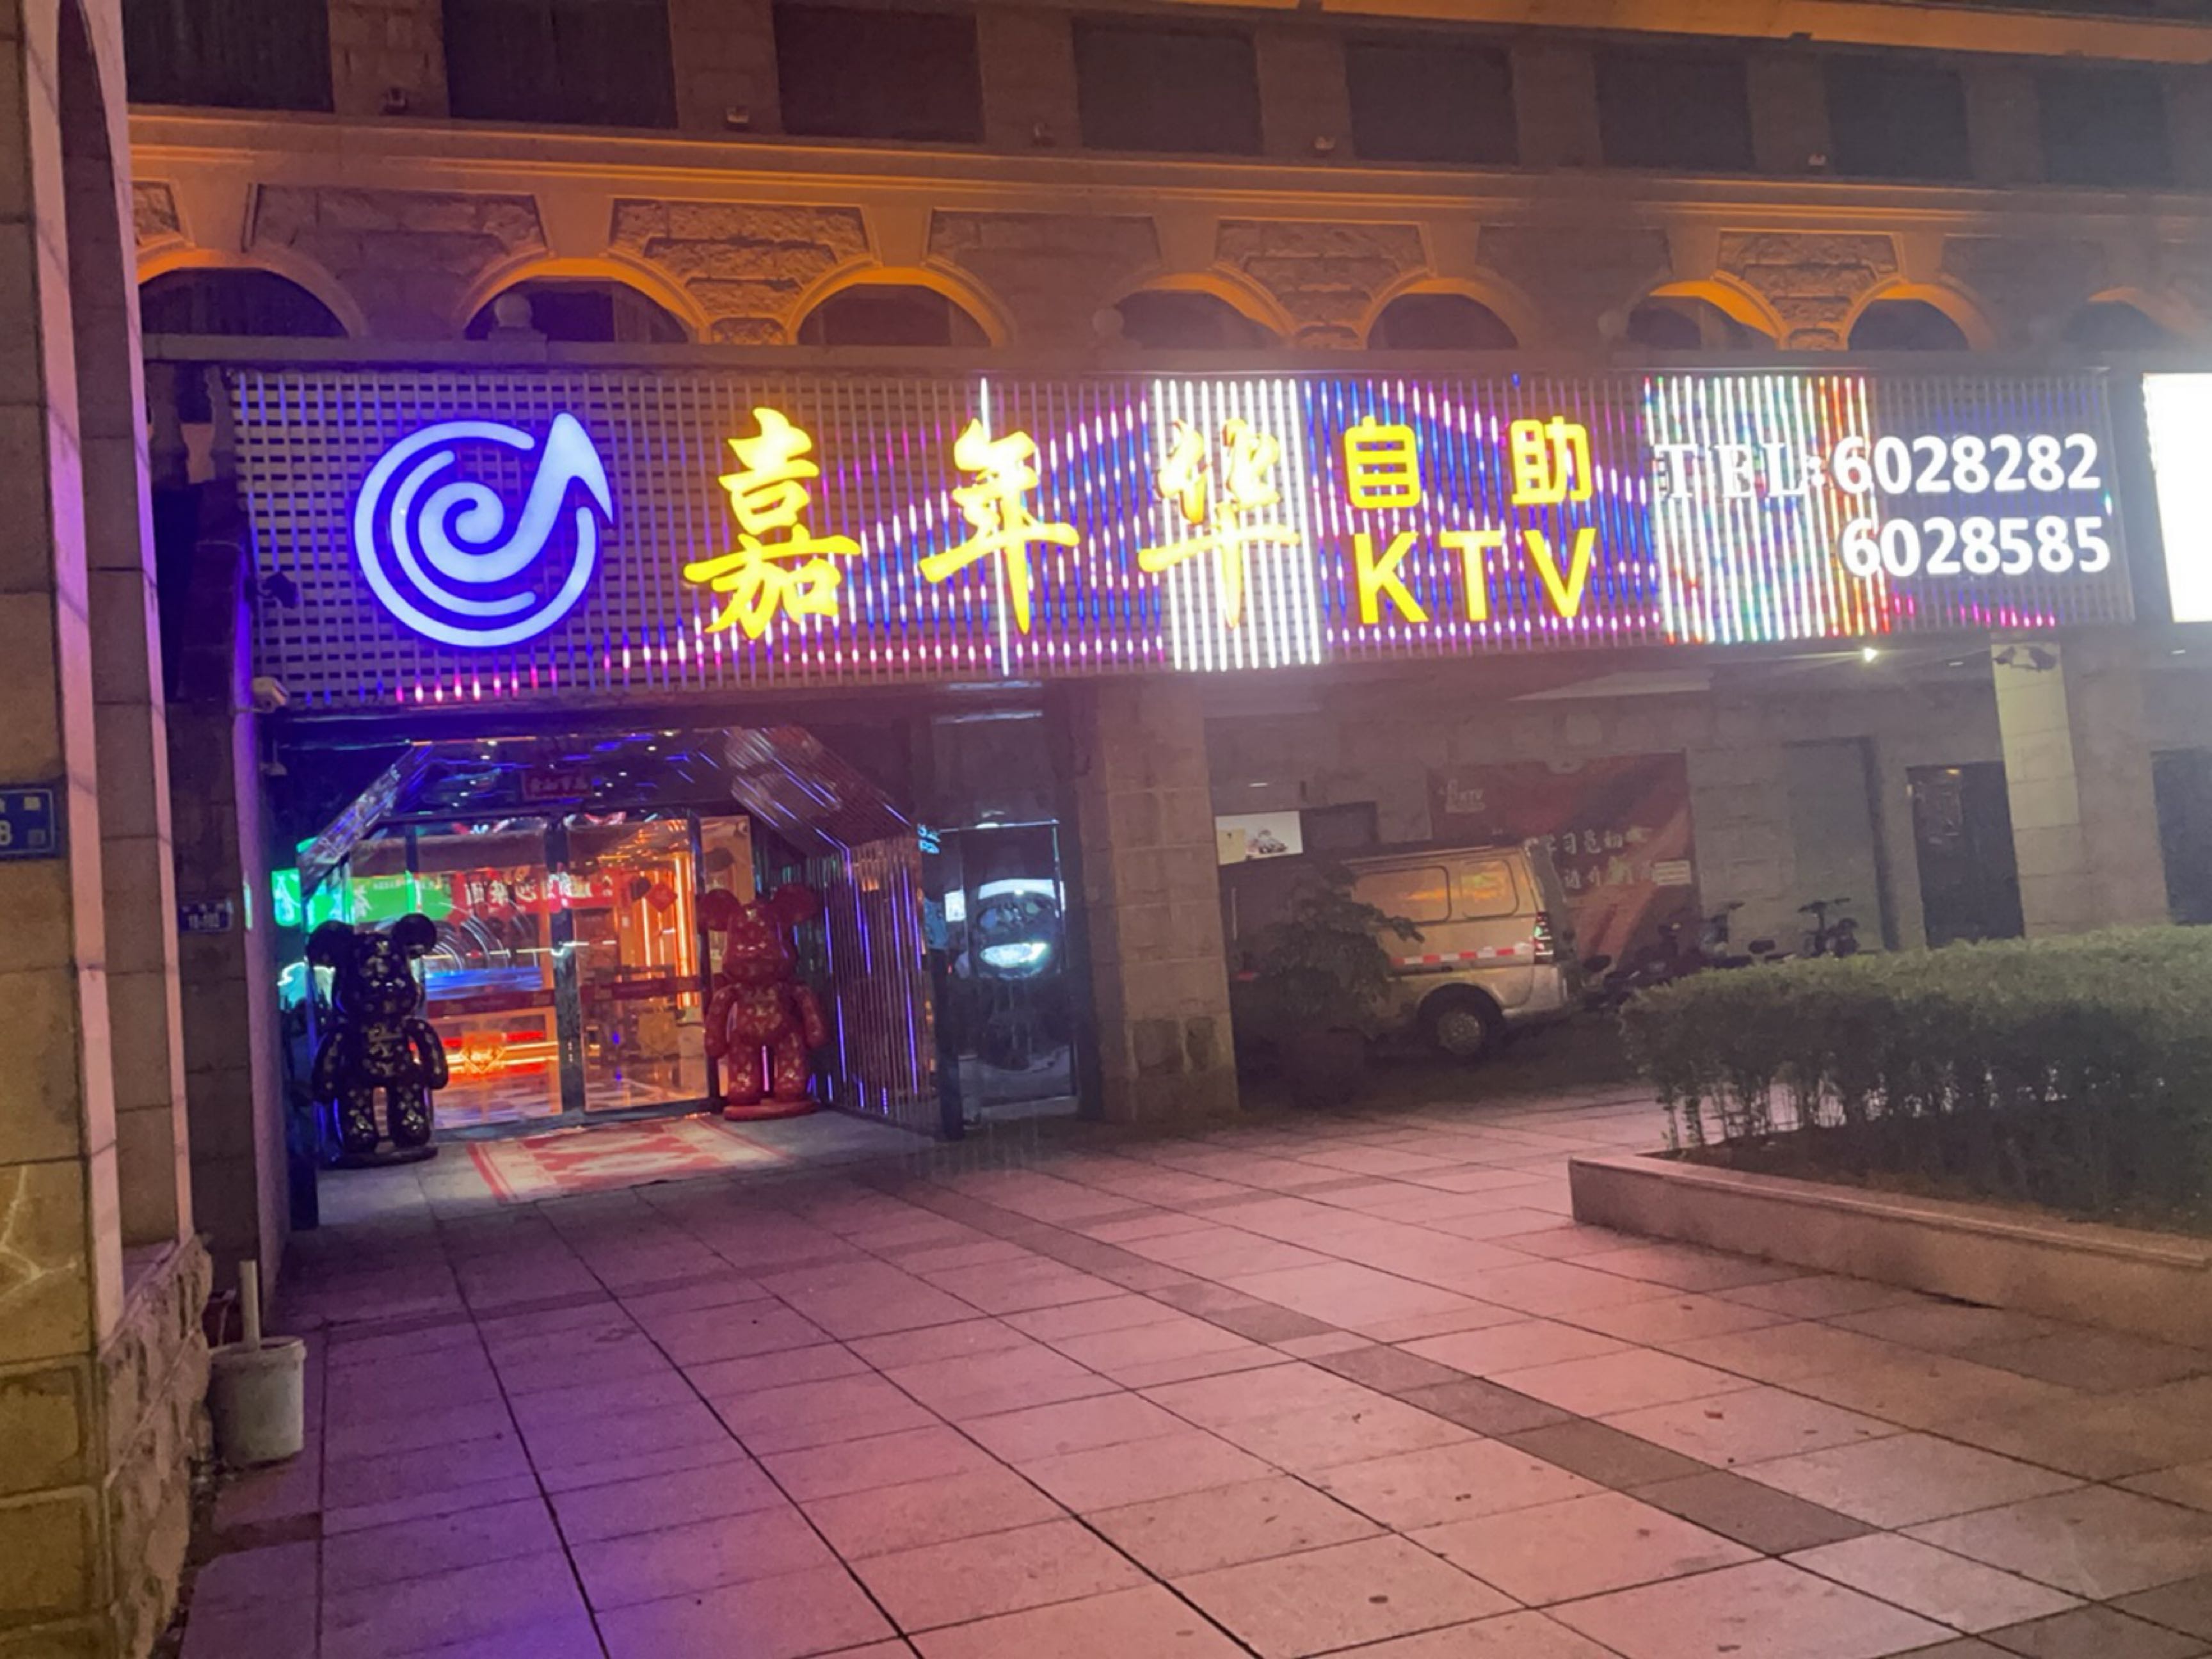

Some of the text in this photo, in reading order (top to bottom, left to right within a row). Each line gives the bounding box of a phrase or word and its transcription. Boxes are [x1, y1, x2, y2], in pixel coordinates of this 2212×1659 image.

[1344, 417, 1593, 508] 自助
[1354, 527, 1596, 623] KTV
[1841, 516, 2111, 577] 6028585
